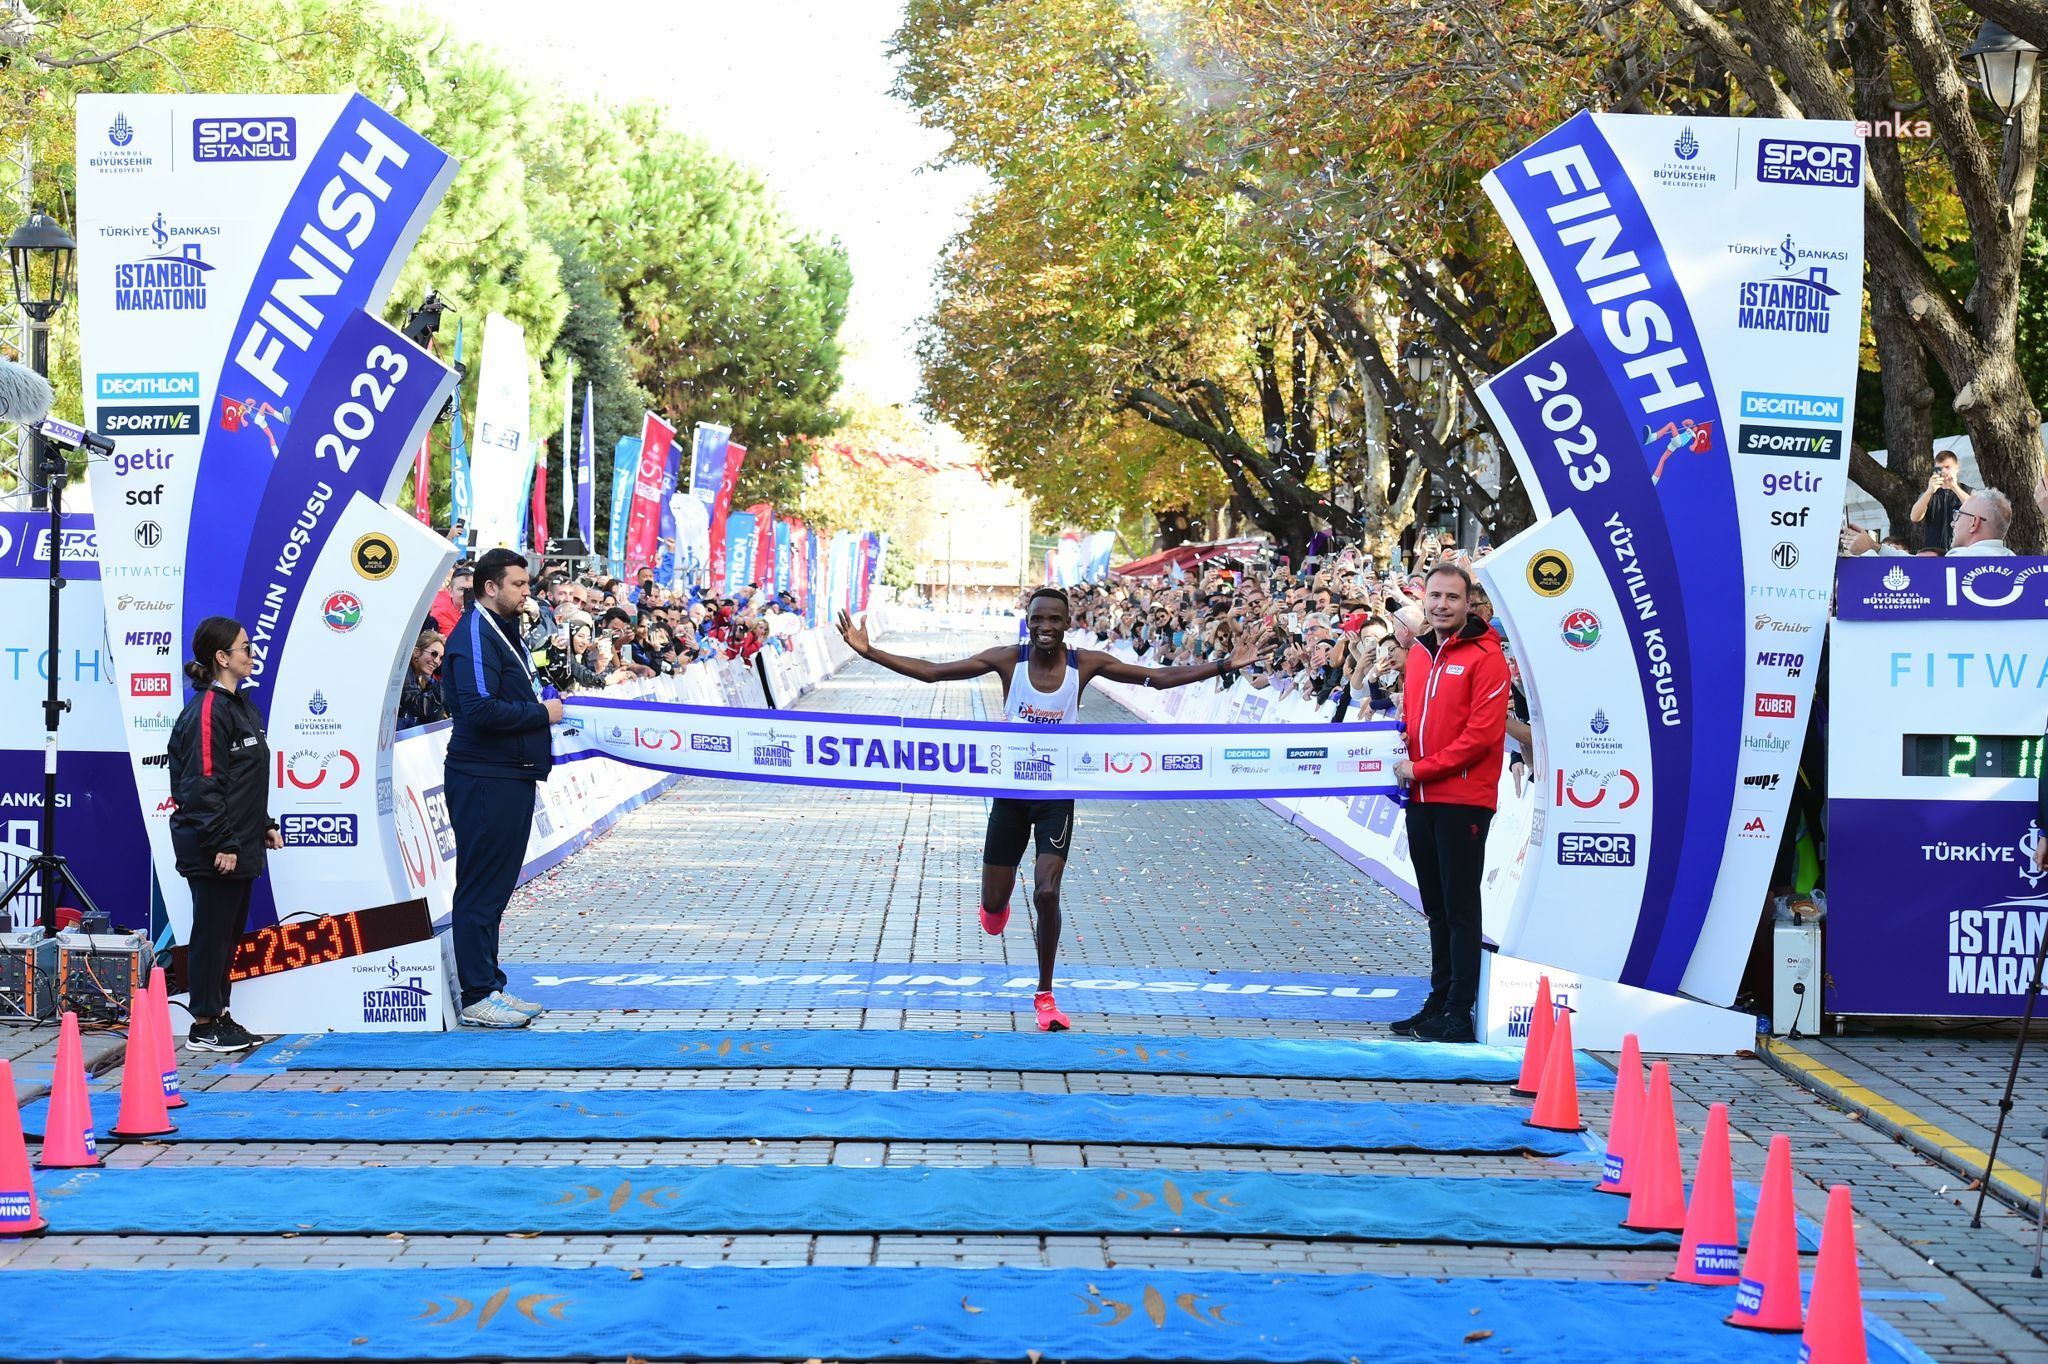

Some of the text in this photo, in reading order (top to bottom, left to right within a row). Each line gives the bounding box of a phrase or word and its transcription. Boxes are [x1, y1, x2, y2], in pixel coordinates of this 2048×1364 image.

[199, 121, 290, 144] SPOR
[90, 155, 153, 168] BÜYÜKŞEHİR
[1764, 143, 1853, 168] SPOR
[1653, 169, 1716, 183] BÜYÜKŞEHİR
[99, 225, 221, 237] TÜRKİYE BANKASI
[234, 117, 411, 398] FINISH
[1727, 243, 1849, 261] TÜRKİYE BANKASI
[1522, 144, 1705, 415] FINISH
[115, 287, 207, 311] MARATONU
[1738, 306, 1830, 334] MARATONU
[102, 378, 193, 394] DECATHLON
[314, 343, 409, 474] 2023
[1746, 397, 1838, 417] DECATHLON
[106, 412, 191, 431] SPORTIVE
[1523, 361, 1611, 492] 2023
[54, 424, 79, 441] LYNX
[1747, 433, 1833, 453] SPORTIVE
[114, 447, 174, 476] getir
[1762, 470, 1823, 496] getir
[125, 484, 165, 505] saf
[1770, 507, 1810, 527] saf
[137, 522, 160, 546] MG
[275, 480, 333, 578] KOŞUSU
[1773, 544, 1798, 567] MG
[105, 566, 183, 577] FITWATCH
[1751, 586, 1828, 601] FITWATCH
[1863, 595, 1931, 605] BÜYÜKŞEHİR
[134, 600, 176, 611] Tchibo
[1603, 511, 1681, 728] YÜZYILIN KOŞUSU
[1770, 621, 1812, 634] Tchibo
[125, 631, 172, 646] METRO
[156, 646, 170, 656] FM
[1756, 651, 1805, 668] METRO
[1787, 668, 1801, 678] FM
[134, 678, 168, 692] ZÜBER
[1758, 697, 1793, 714] ZÜBER
[294, 722, 343, 732] BÜYÜKŞEHİR
[1027, 715, 1063, 724] DEPOT
[693, 735, 729, 746] SPOR
[1575, 740, 1623, 750] BÜYÜKŞEHİR
[1744, 735, 1791, 753] Hamidiye
[805, 735, 988, 774] ISTANBUL
[991, 744, 1002, 775] 2023
[1163, 754, 1201, 764] SPOR
[1226, 749, 1269, 759] DECATHLON
[1290, 750, 1326, 758] SPORTIVE
[1347, 747, 1374, 759] getir
[754, 757, 792, 768] MARATONU
[1298, 764, 1322, 772] METRO
[1014, 771, 1053, 781] MARATHON
[0, 792, 72, 808] ANKSI
[284, 816, 354, 834] SPOR
[1562, 835, 1631, 854] SPOR
[1921, 841, 2015, 862] TÜRKİYE
[352, 964, 436, 973] TÜRKİYE BANKASI
[363, 1007, 427, 1024] MARATHON
[1696, 1247, 1716, 1256] SPOR
